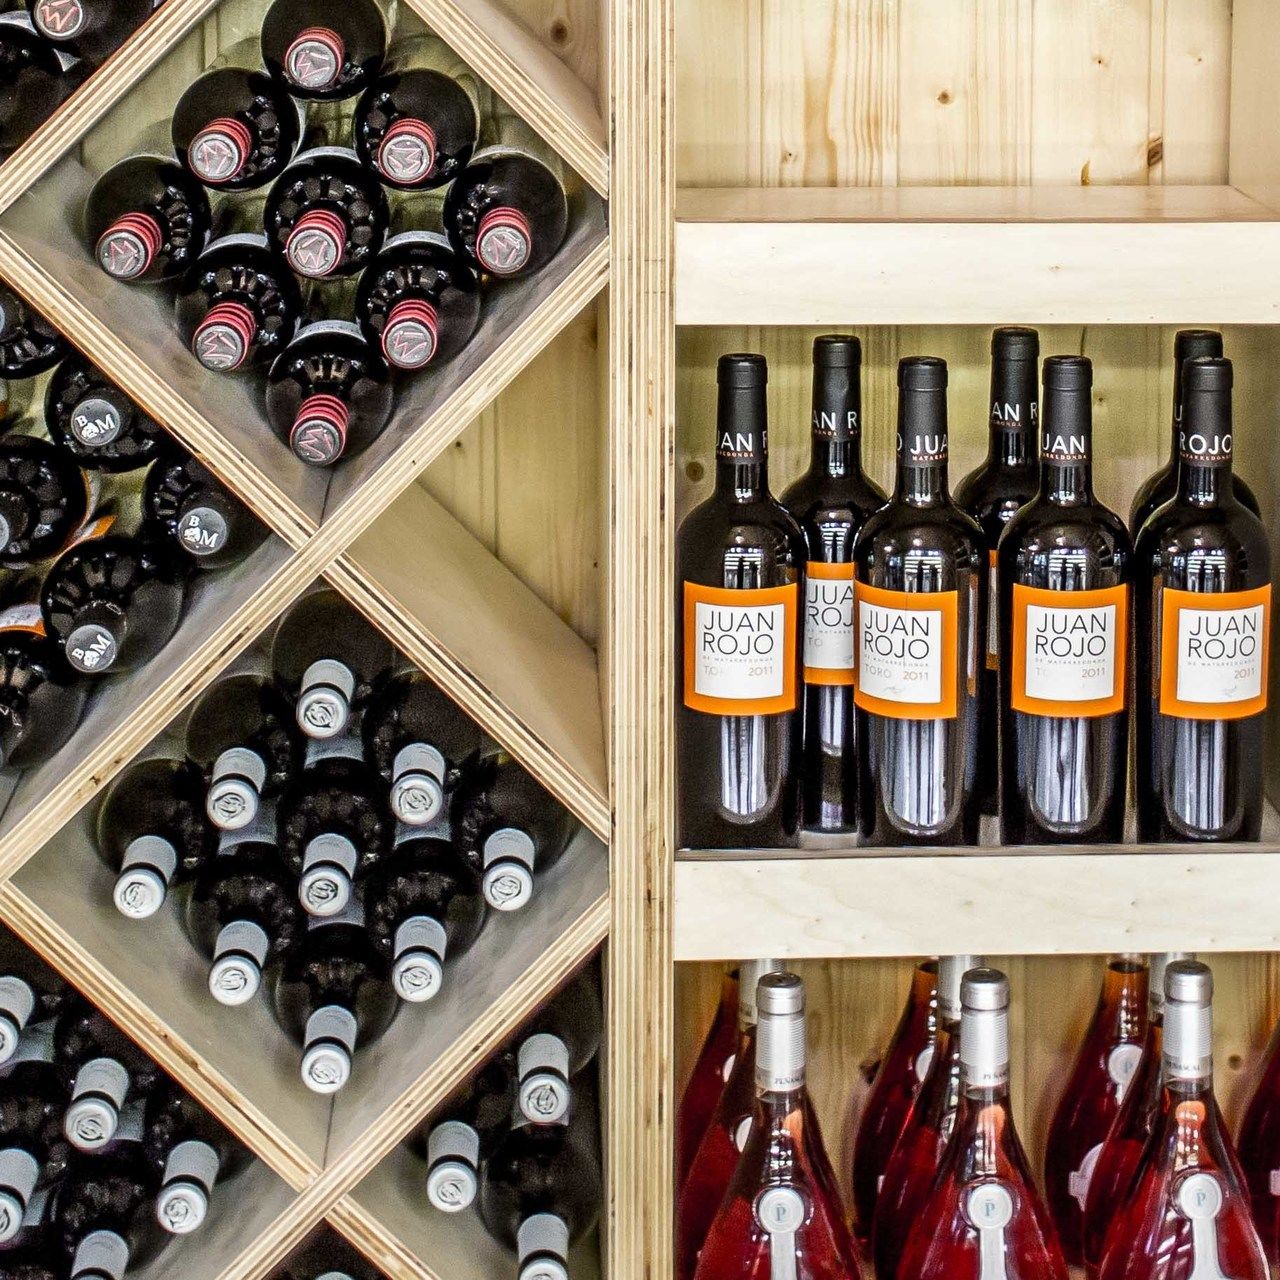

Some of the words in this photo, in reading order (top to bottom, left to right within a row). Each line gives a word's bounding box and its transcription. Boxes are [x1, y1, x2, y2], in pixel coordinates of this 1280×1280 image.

[910, 434, 947, 454] JUA
[808, 585, 853, 605] JUA
[703, 610, 774, 632] JUAN
[808, 607, 853, 627] ROJ
[865, 610, 930, 636] JUAN
[1036, 612, 1107, 634] JUAN
[1189, 612, 1257, 636] JUAN
[703, 634, 774, 655] ROJO
[864, 631, 930, 660] ROJO
[1035, 635, 1106, 657] ROJO
[1188, 635, 1256, 659] ROJO
[748, 666, 773, 677] 2011
[902, 670, 929, 681] 2011
